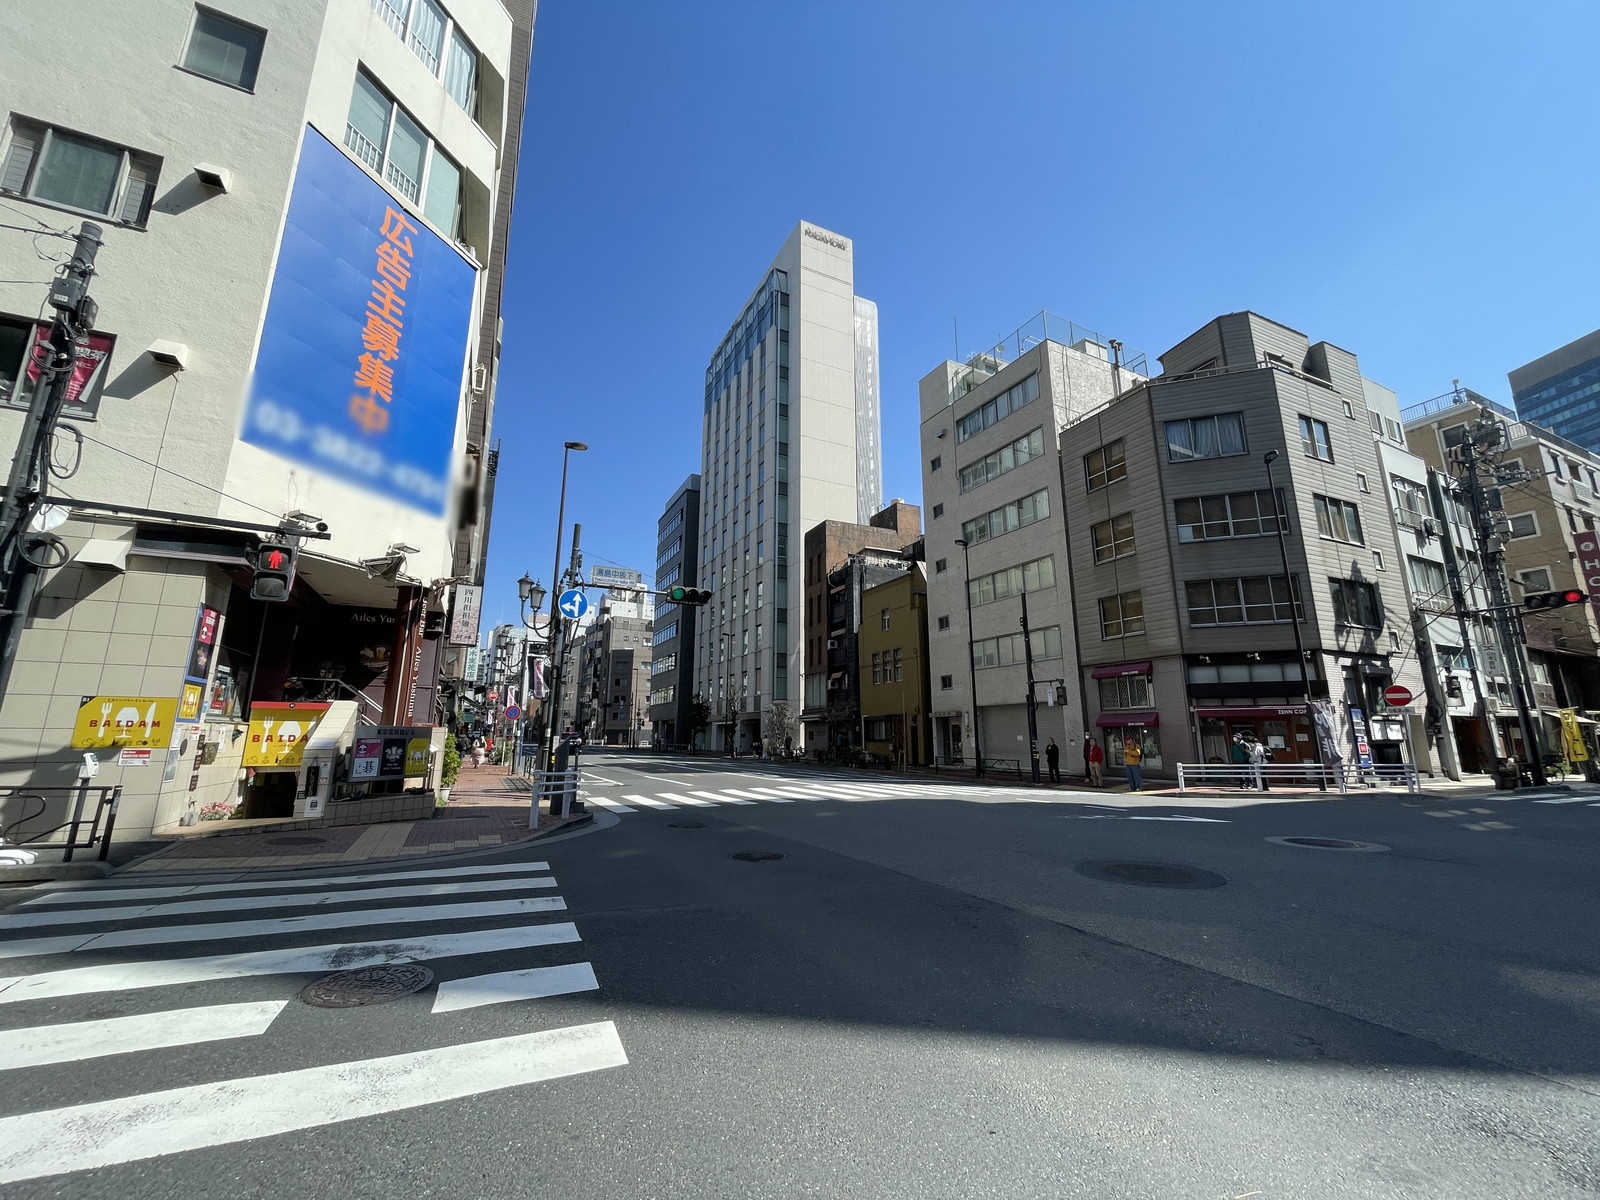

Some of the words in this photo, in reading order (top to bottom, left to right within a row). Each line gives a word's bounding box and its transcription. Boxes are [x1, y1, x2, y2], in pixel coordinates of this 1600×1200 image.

[596, 568, 634, 580] 湯島中坂下
[351, 612, 376, 623] Ailes
[89, 720, 161, 728] BAIDAM
